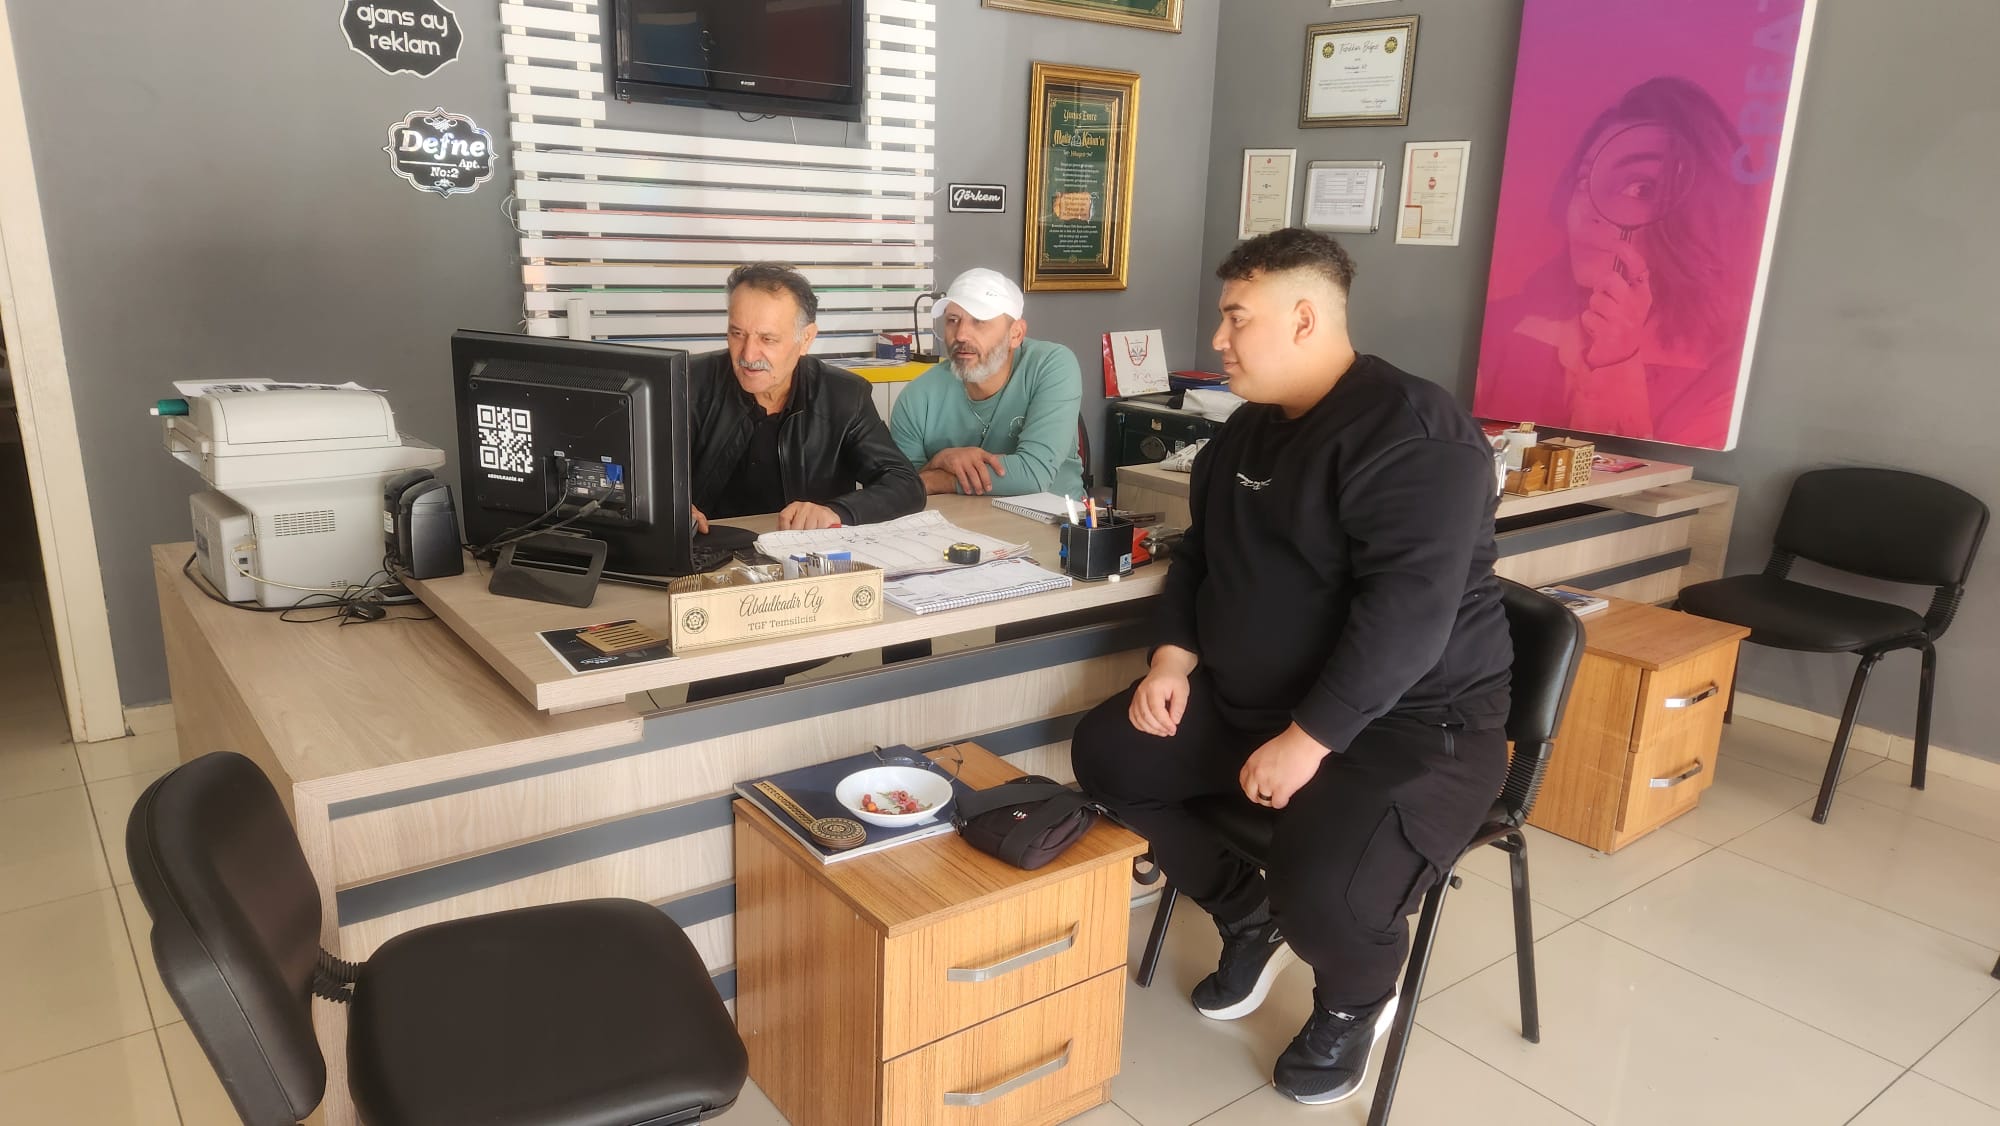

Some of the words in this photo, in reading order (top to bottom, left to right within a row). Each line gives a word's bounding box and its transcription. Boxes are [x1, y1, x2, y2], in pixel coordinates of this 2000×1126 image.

[357, 4, 415, 30] ajans
[420, 13, 448, 38] ay
[369, 30, 441, 55] reklam
[1730, 0, 1805, 185] CREA
[399, 129, 486, 161] Defne
[430, 166, 460, 178] No:2
[458, 158, 481, 170] Apt.
[953, 188, 1001, 207] Görkem
[738, 592, 801, 618] Abdulkadir
[803, 585, 825, 613] Ay
[748, 621, 767, 632] TGF
[769, 614, 817, 630] Temsilcisi
